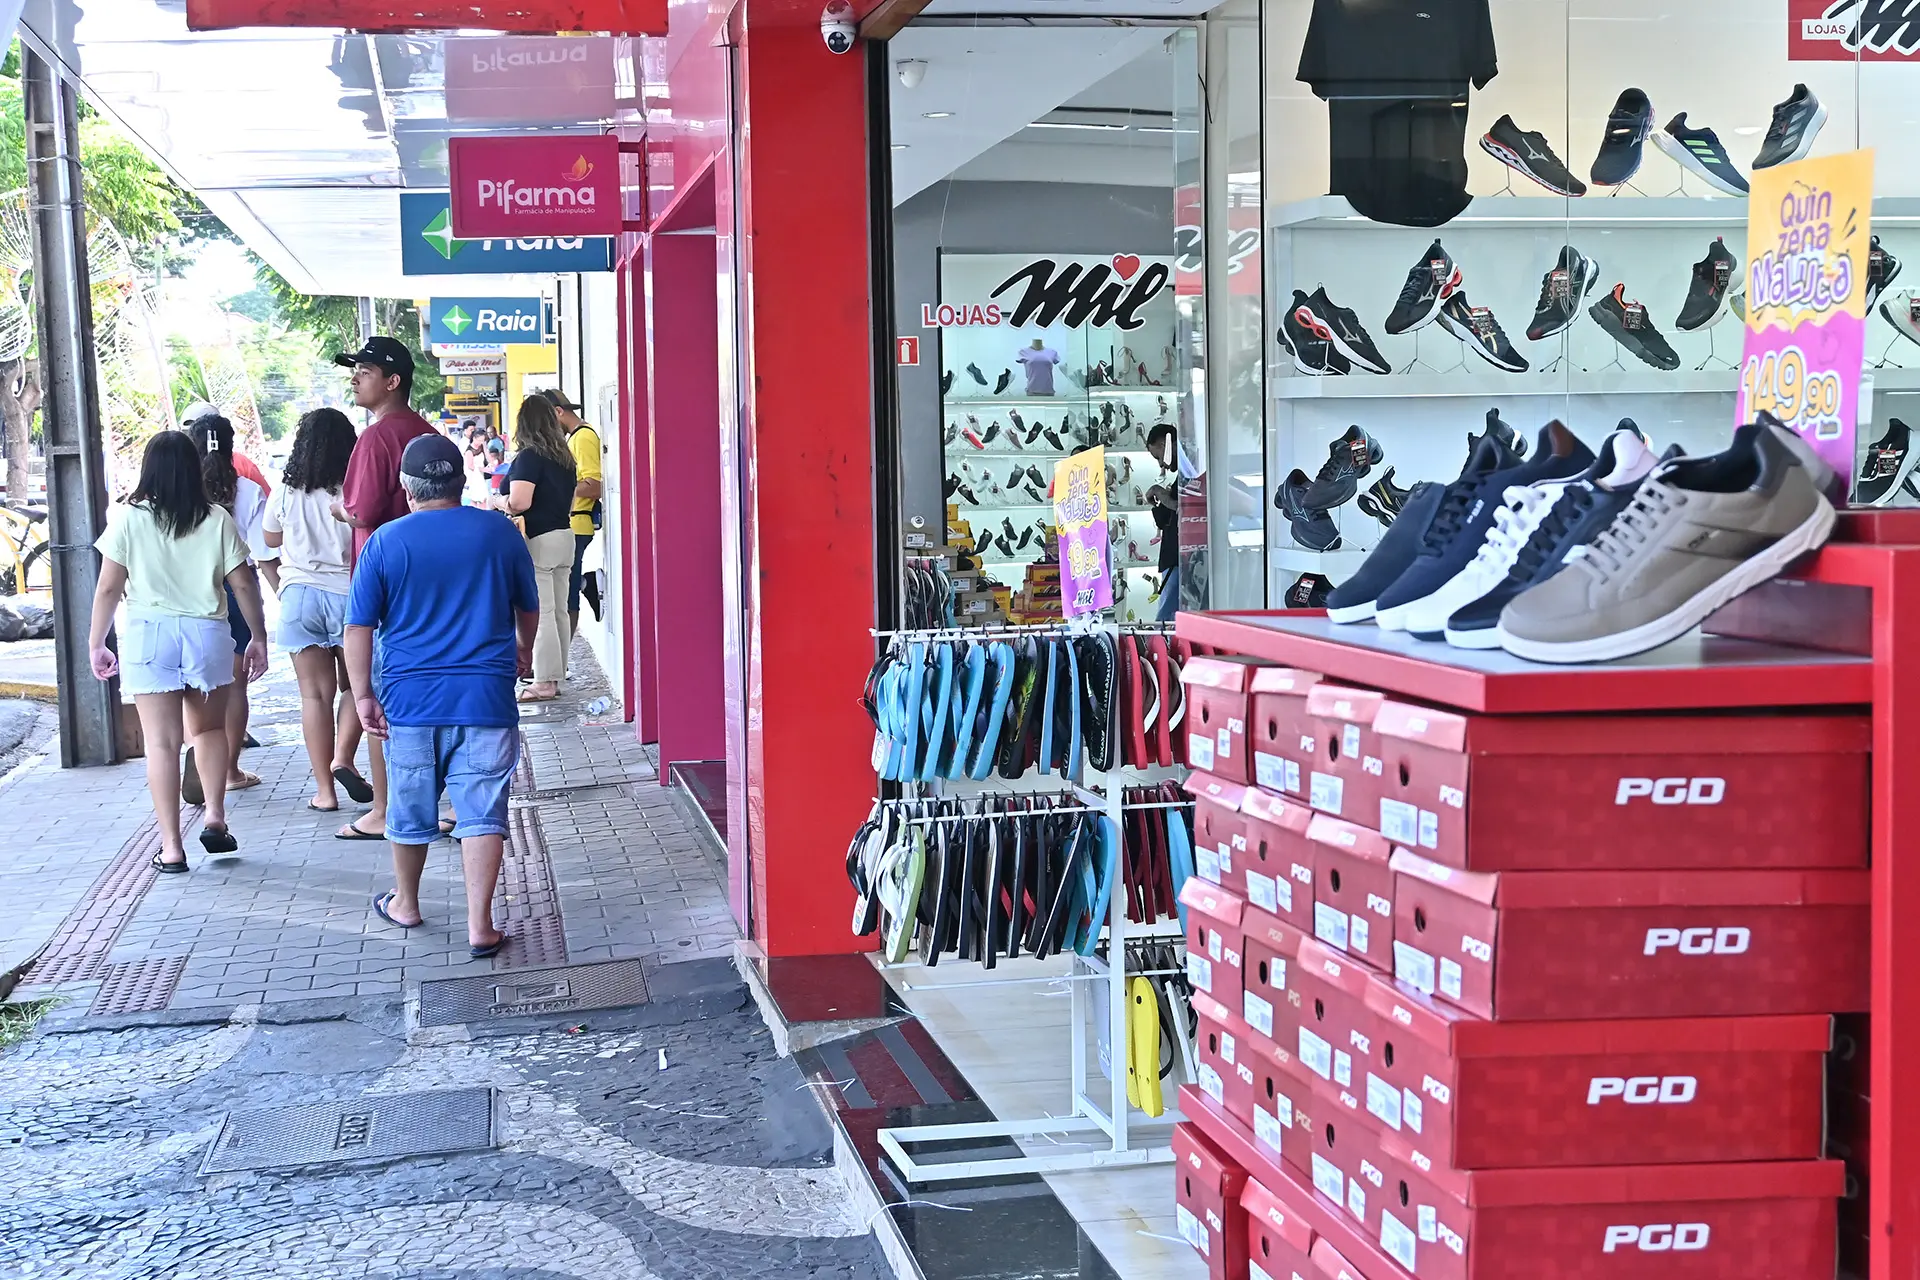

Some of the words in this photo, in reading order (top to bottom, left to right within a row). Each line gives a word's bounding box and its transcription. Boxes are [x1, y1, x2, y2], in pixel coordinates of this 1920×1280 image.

[1807, 25, 1846, 35] LOJAS
[478, 179, 596, 215] Pifarma
[515, 207, 544, 215] Farmácia
[554, 206, 596, 215] Manipulação
[1780, 186, 1832, 229] Quin
[476, 309, 537, 332] Raia
[921, 303, 1002, 328] LOJAS
[1615, 776, 1726, 805] PGD
[1643, 926, 1751, 956] PGD
[1586, 1075, 1698, 1105] PGD
[1603, 1222, 1711, 1253] PGD
